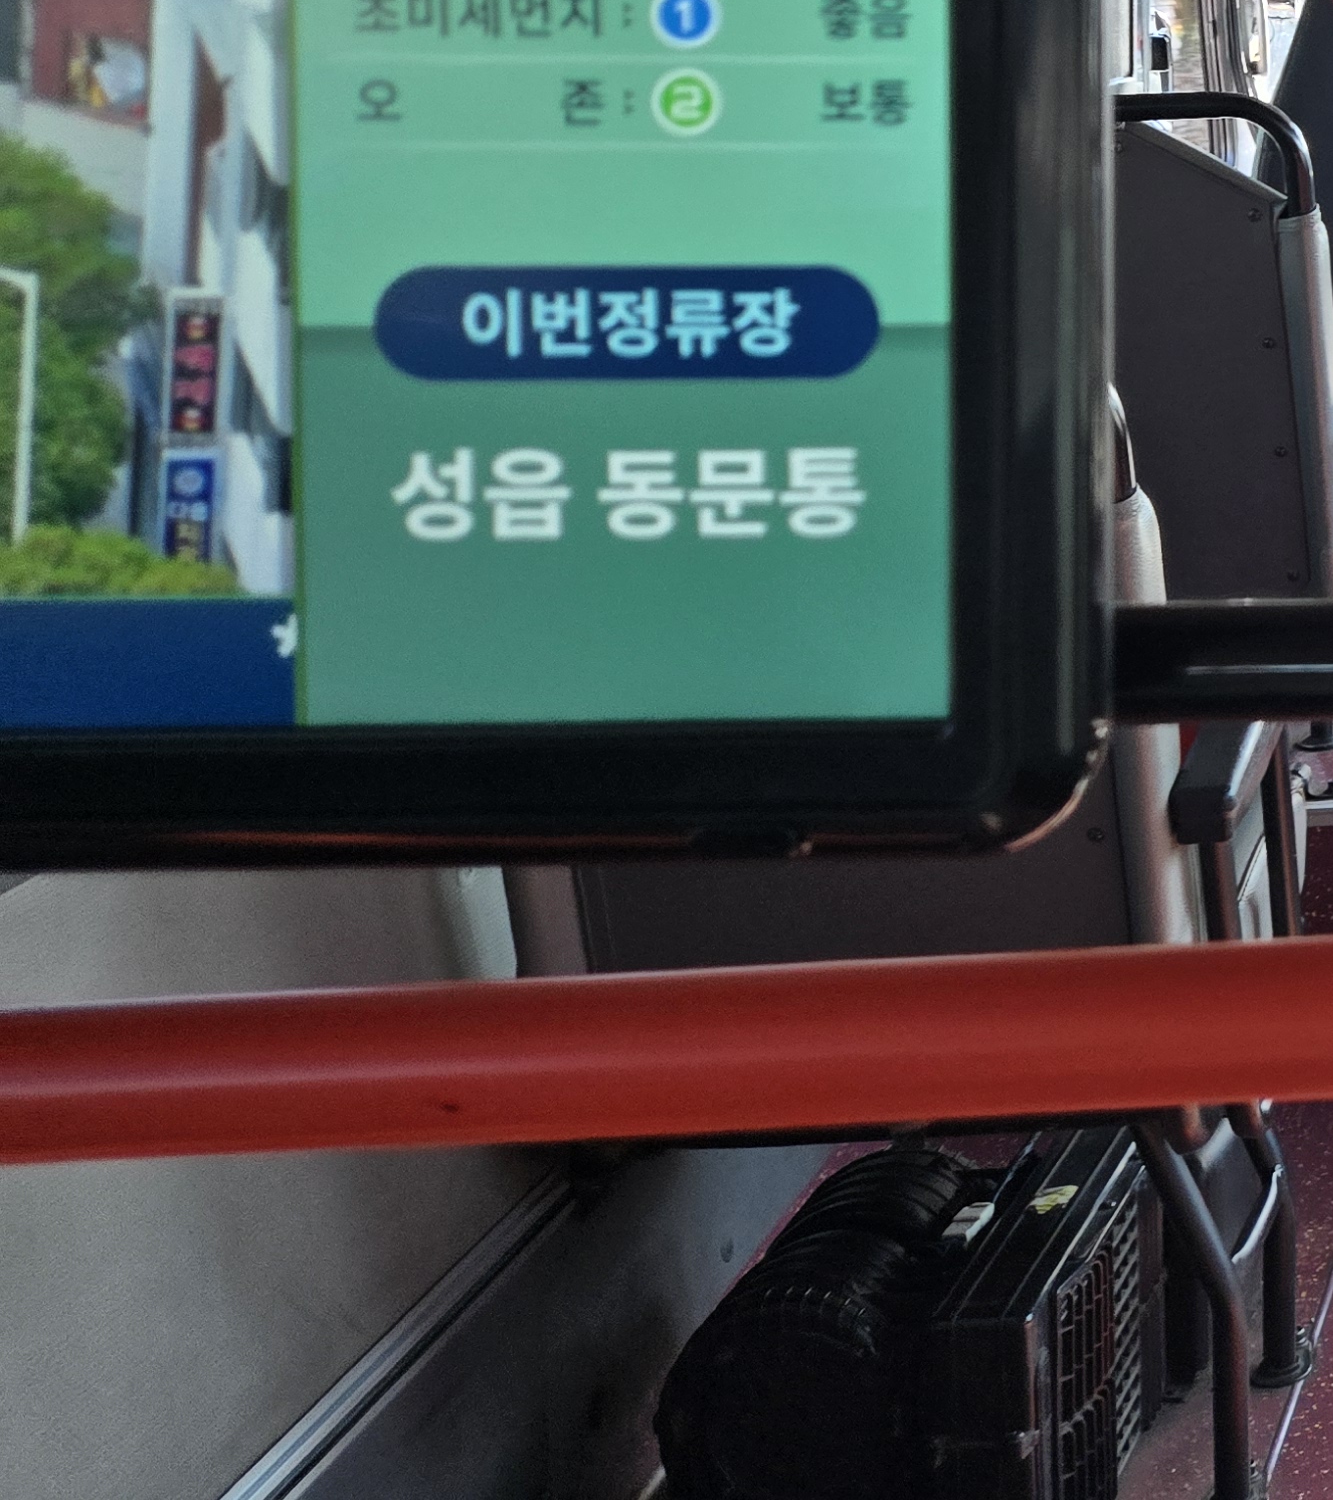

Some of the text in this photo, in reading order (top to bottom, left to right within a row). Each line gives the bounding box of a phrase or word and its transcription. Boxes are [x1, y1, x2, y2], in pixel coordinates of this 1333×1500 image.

[821, 78, 913, 128] 보통
[460, 287, 800, 360] 이번정류장
[390, 445, 868, 542] 성읍 동문통
